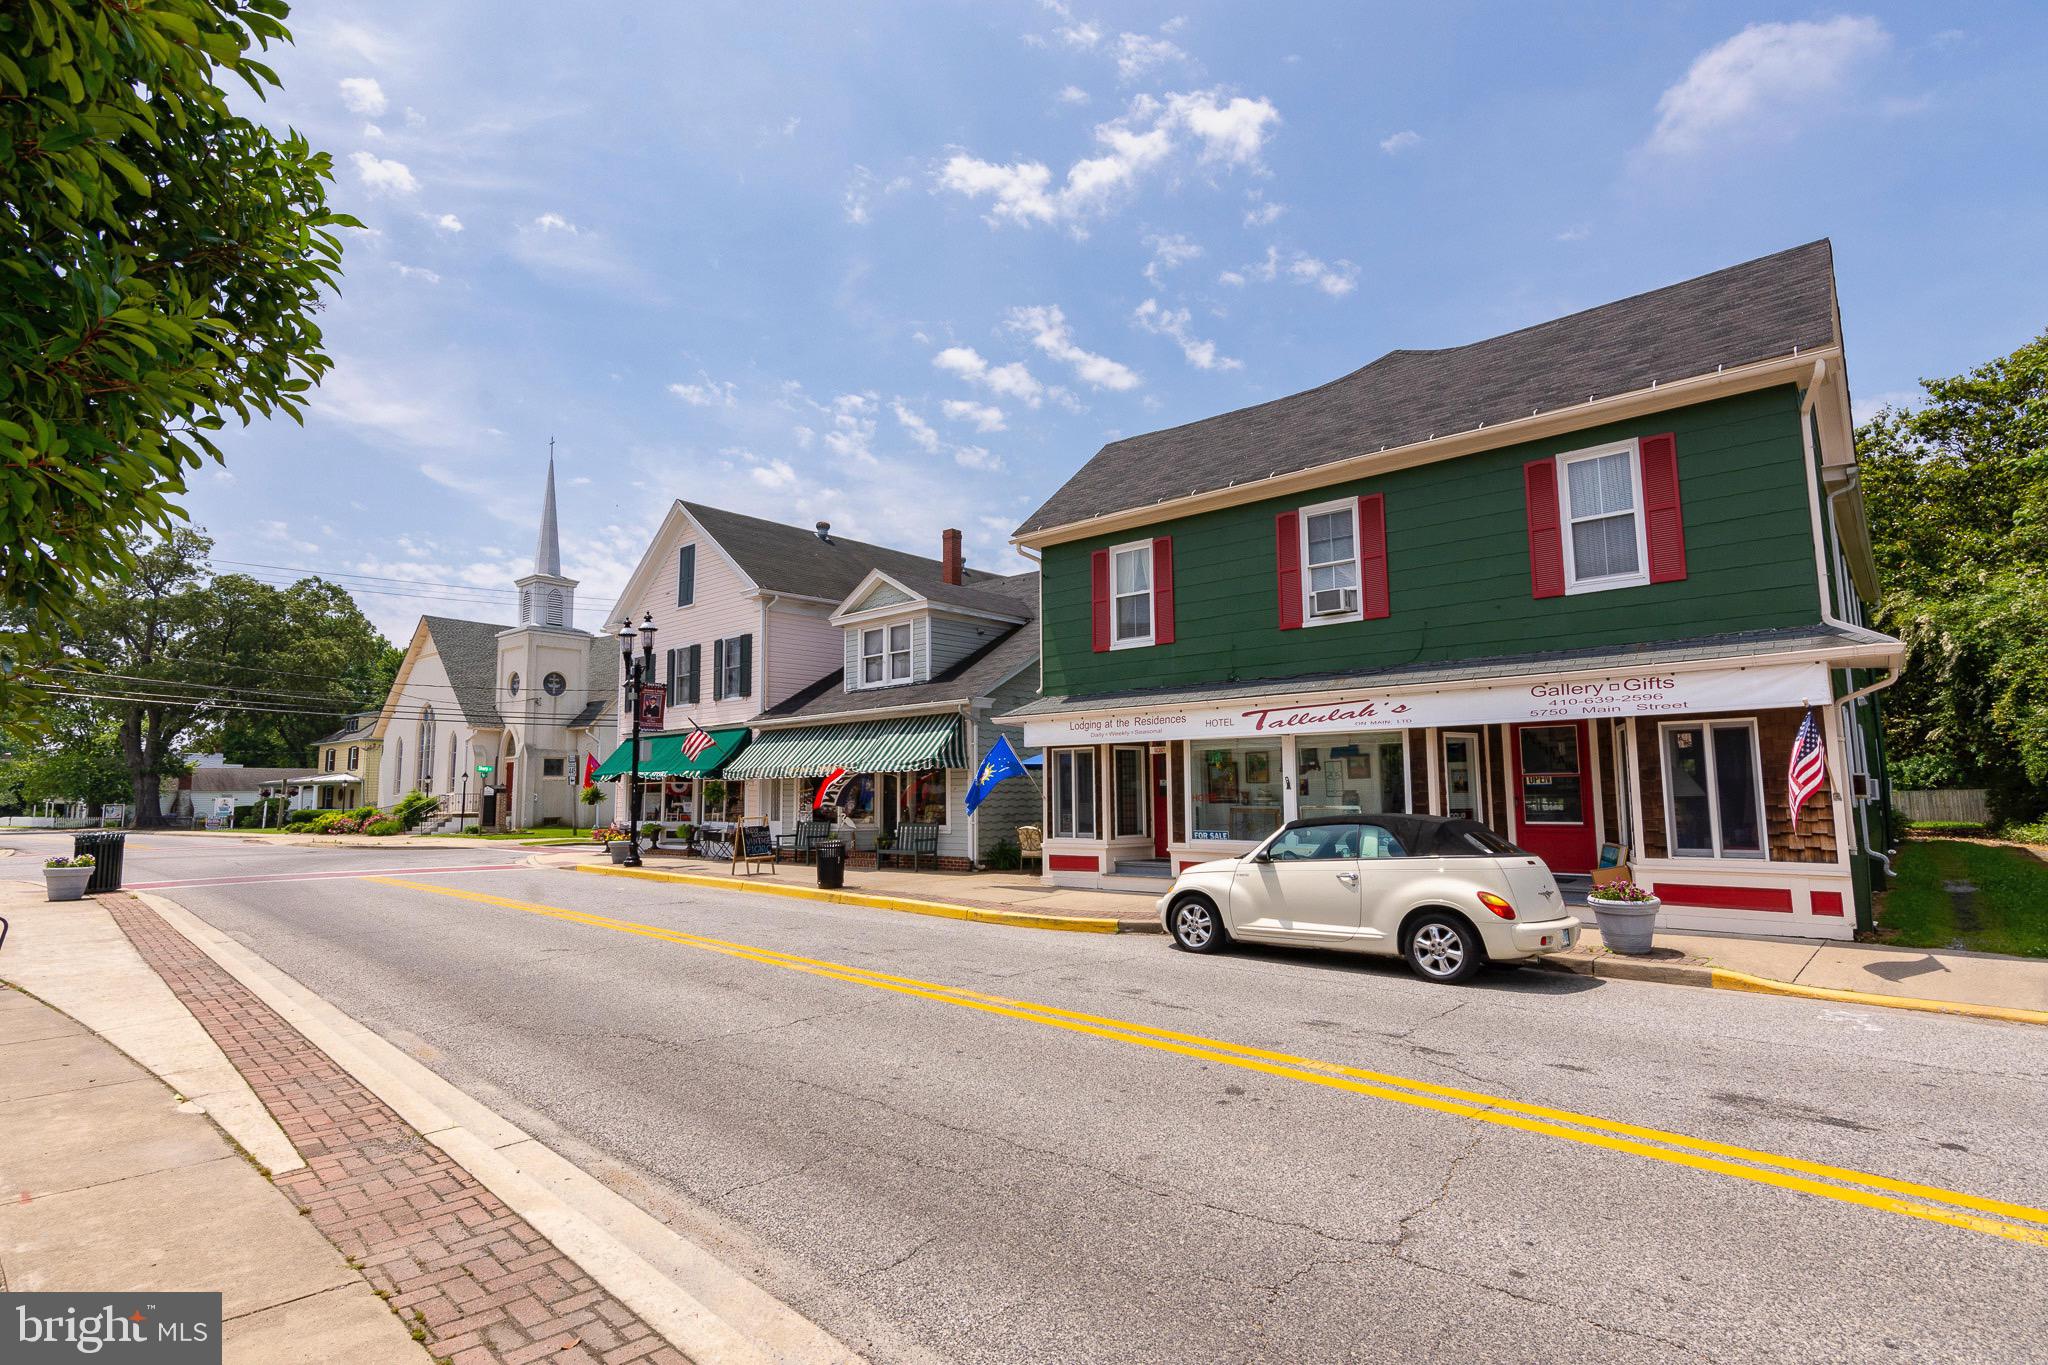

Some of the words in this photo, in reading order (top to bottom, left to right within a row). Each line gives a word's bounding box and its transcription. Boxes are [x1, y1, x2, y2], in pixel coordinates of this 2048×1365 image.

[1531, 683, 1604, 697] Gallery
[1624, 677, 1675, 691] Gifts
[1549, 693, 1663, 706] 410-639-2596
[1241, 699, 1412, 731] Tallulah's
[1530, 708, 1568, 717] 5750
[1582, 705, 1621, 714] Main
[1636, 701, 1689, 711] Street
[1069, 720, 1102, 731] Lodging
[1104, 720, 1113, 728] at
[1116, 719, 1130, 728] the
[1134, 714, 1187, 727] Residences
[1205, 717, 1234, 727] HOTEL
[1134, 728, 1163, 736] Seasonal
[1528, 775, 1551, 784] OPEN
[1193, 831, 1208, 839] FOR
[1209, 832, 1228, 840] SALE
